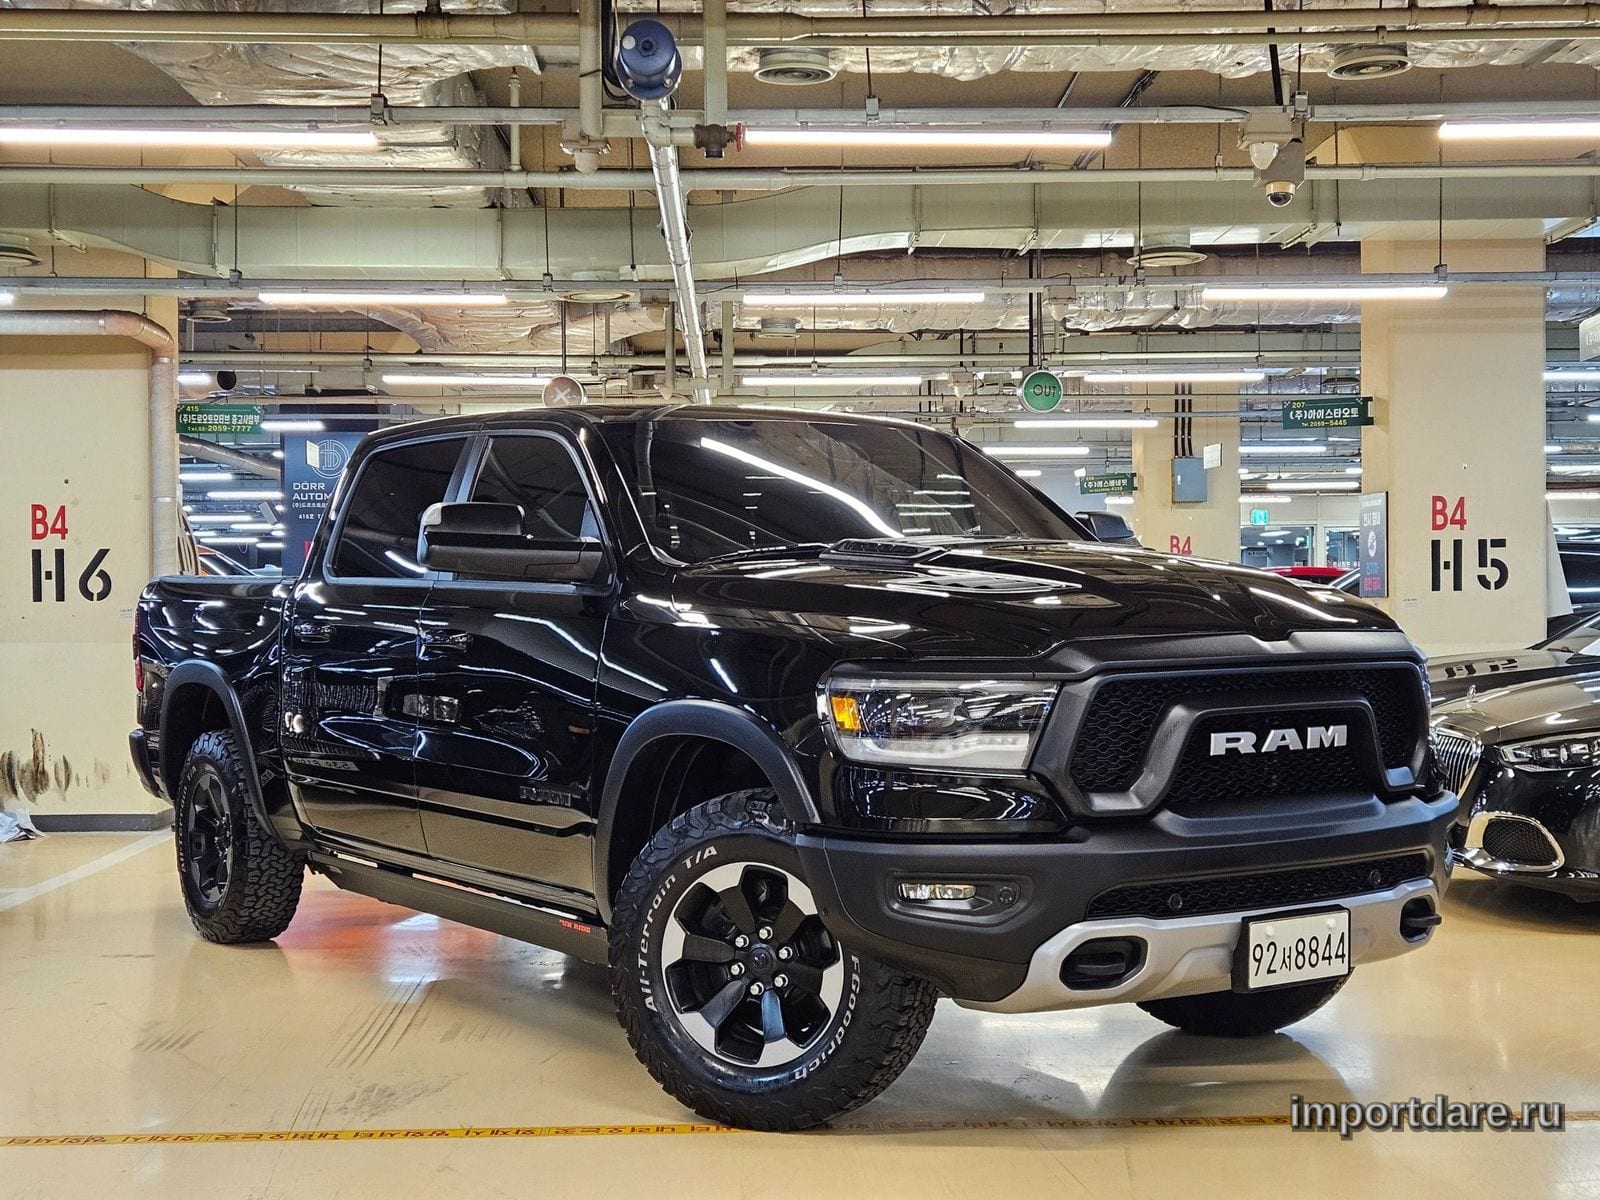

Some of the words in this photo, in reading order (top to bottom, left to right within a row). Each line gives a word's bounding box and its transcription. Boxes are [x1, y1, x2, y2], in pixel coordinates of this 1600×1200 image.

[1032, 383, 1057, 398] OUT
[1289, 407, 1359, 420] (주)아이스타오토
[30, 503, 69, 541] B4
[1432, 495, 1468, 532] B4
[1169, 534, 1193, 555] B4
[1209, 724, 1348, 757] RAM
[638, 874, 677, 1013] All-Terrain
[683, 845, 718, 871] T/A
[1252, 931, 1347, 977] 92서8844
[794, 953, 862, 1081] FGoodrich
